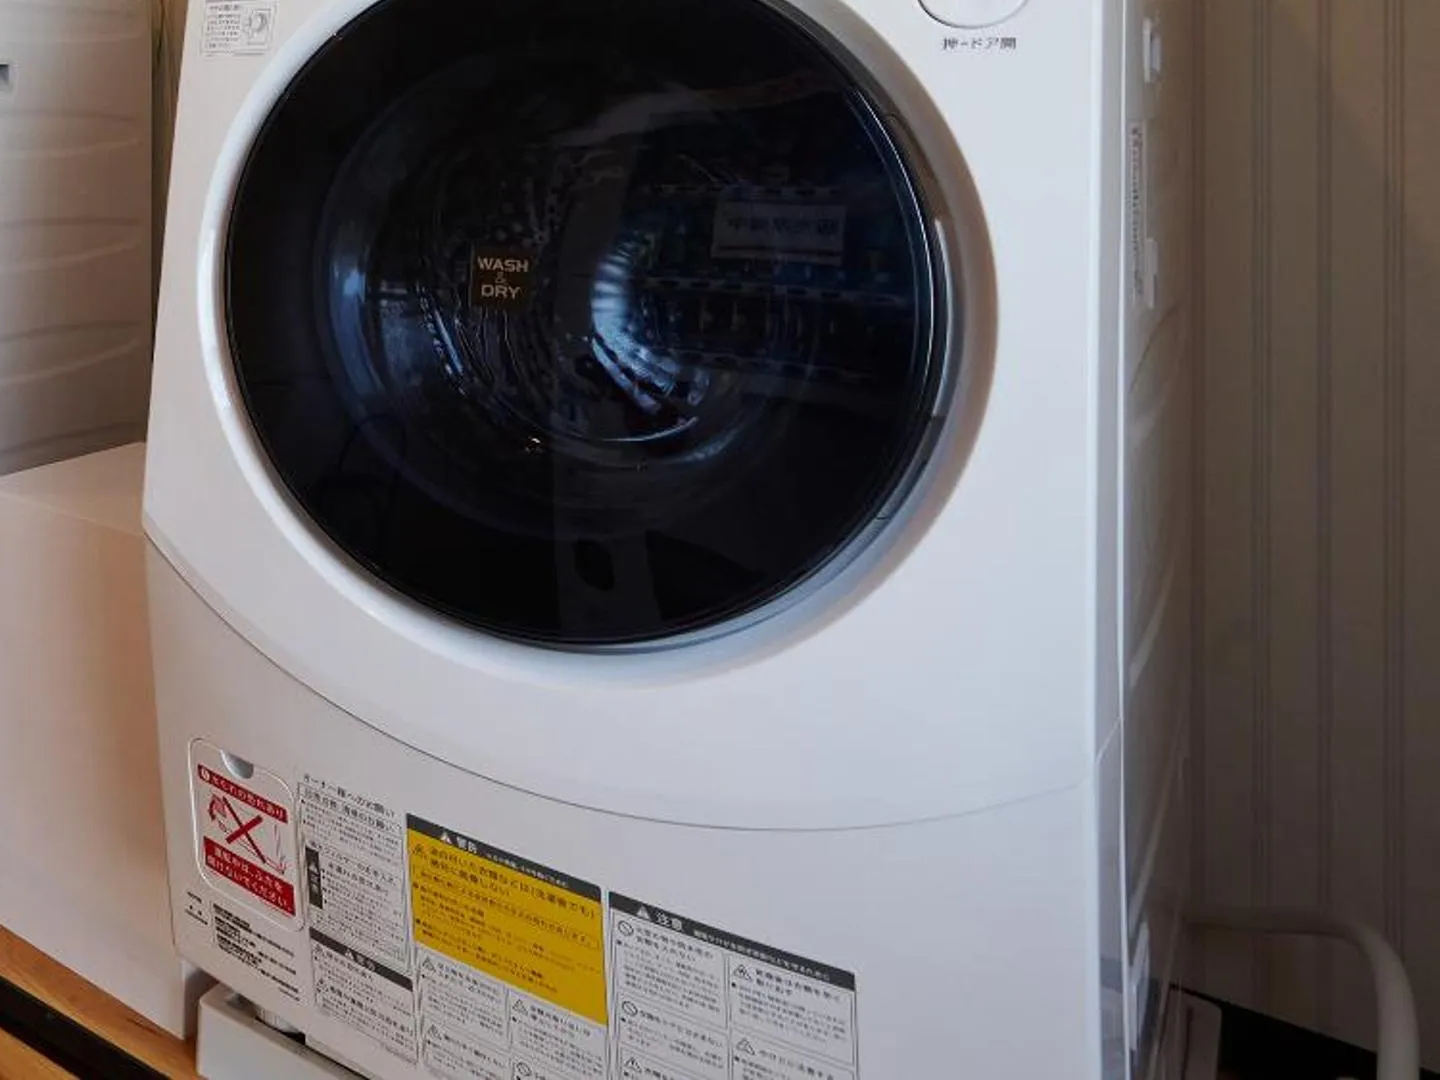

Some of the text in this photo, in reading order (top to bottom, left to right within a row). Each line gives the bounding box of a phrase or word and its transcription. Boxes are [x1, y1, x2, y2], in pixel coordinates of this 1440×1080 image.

[477, 256, 529, 272] WASH
[495, 272, 507, 283] &
[481, 284, 521, 300] DRY
